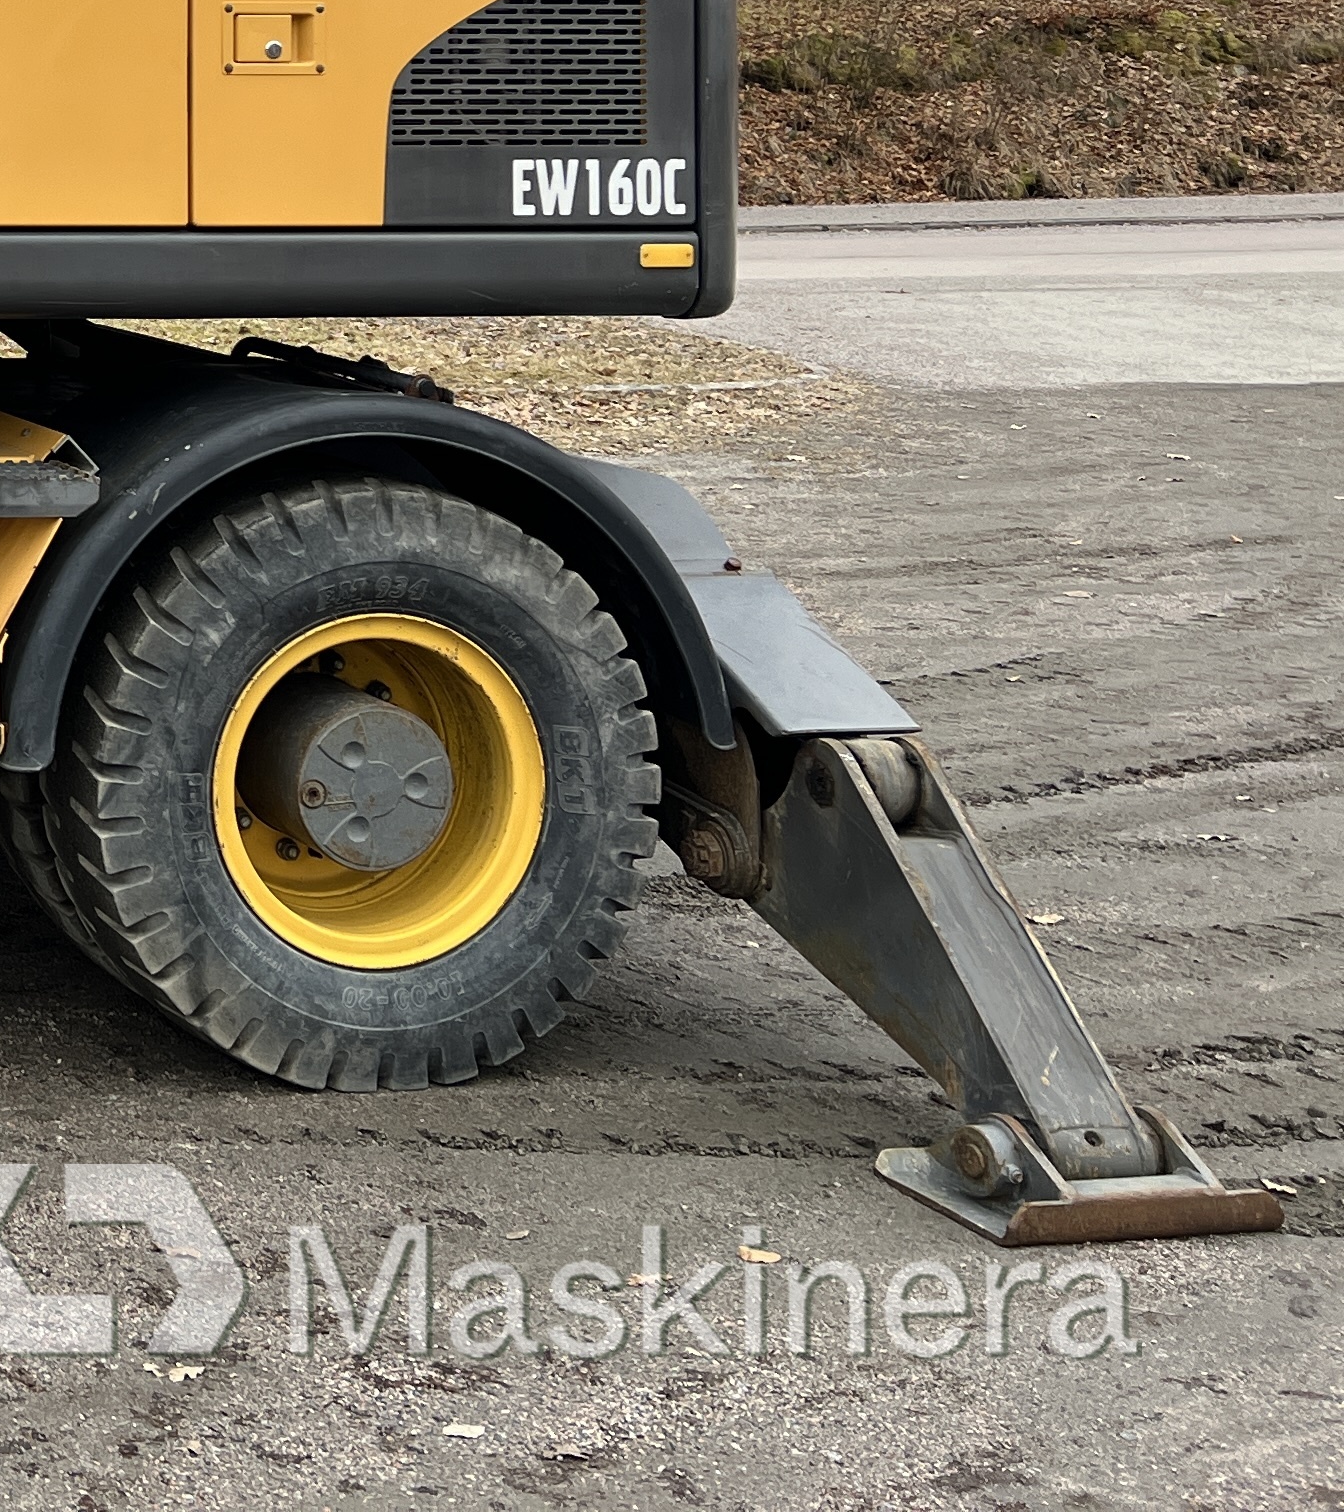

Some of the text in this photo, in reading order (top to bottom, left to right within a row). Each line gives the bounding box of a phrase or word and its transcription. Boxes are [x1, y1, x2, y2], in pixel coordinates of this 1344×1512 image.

[512, 158, 687, 216] EW160C
[375, 575, 430, 601] 934
[553, 724, 596, 815] BKT
